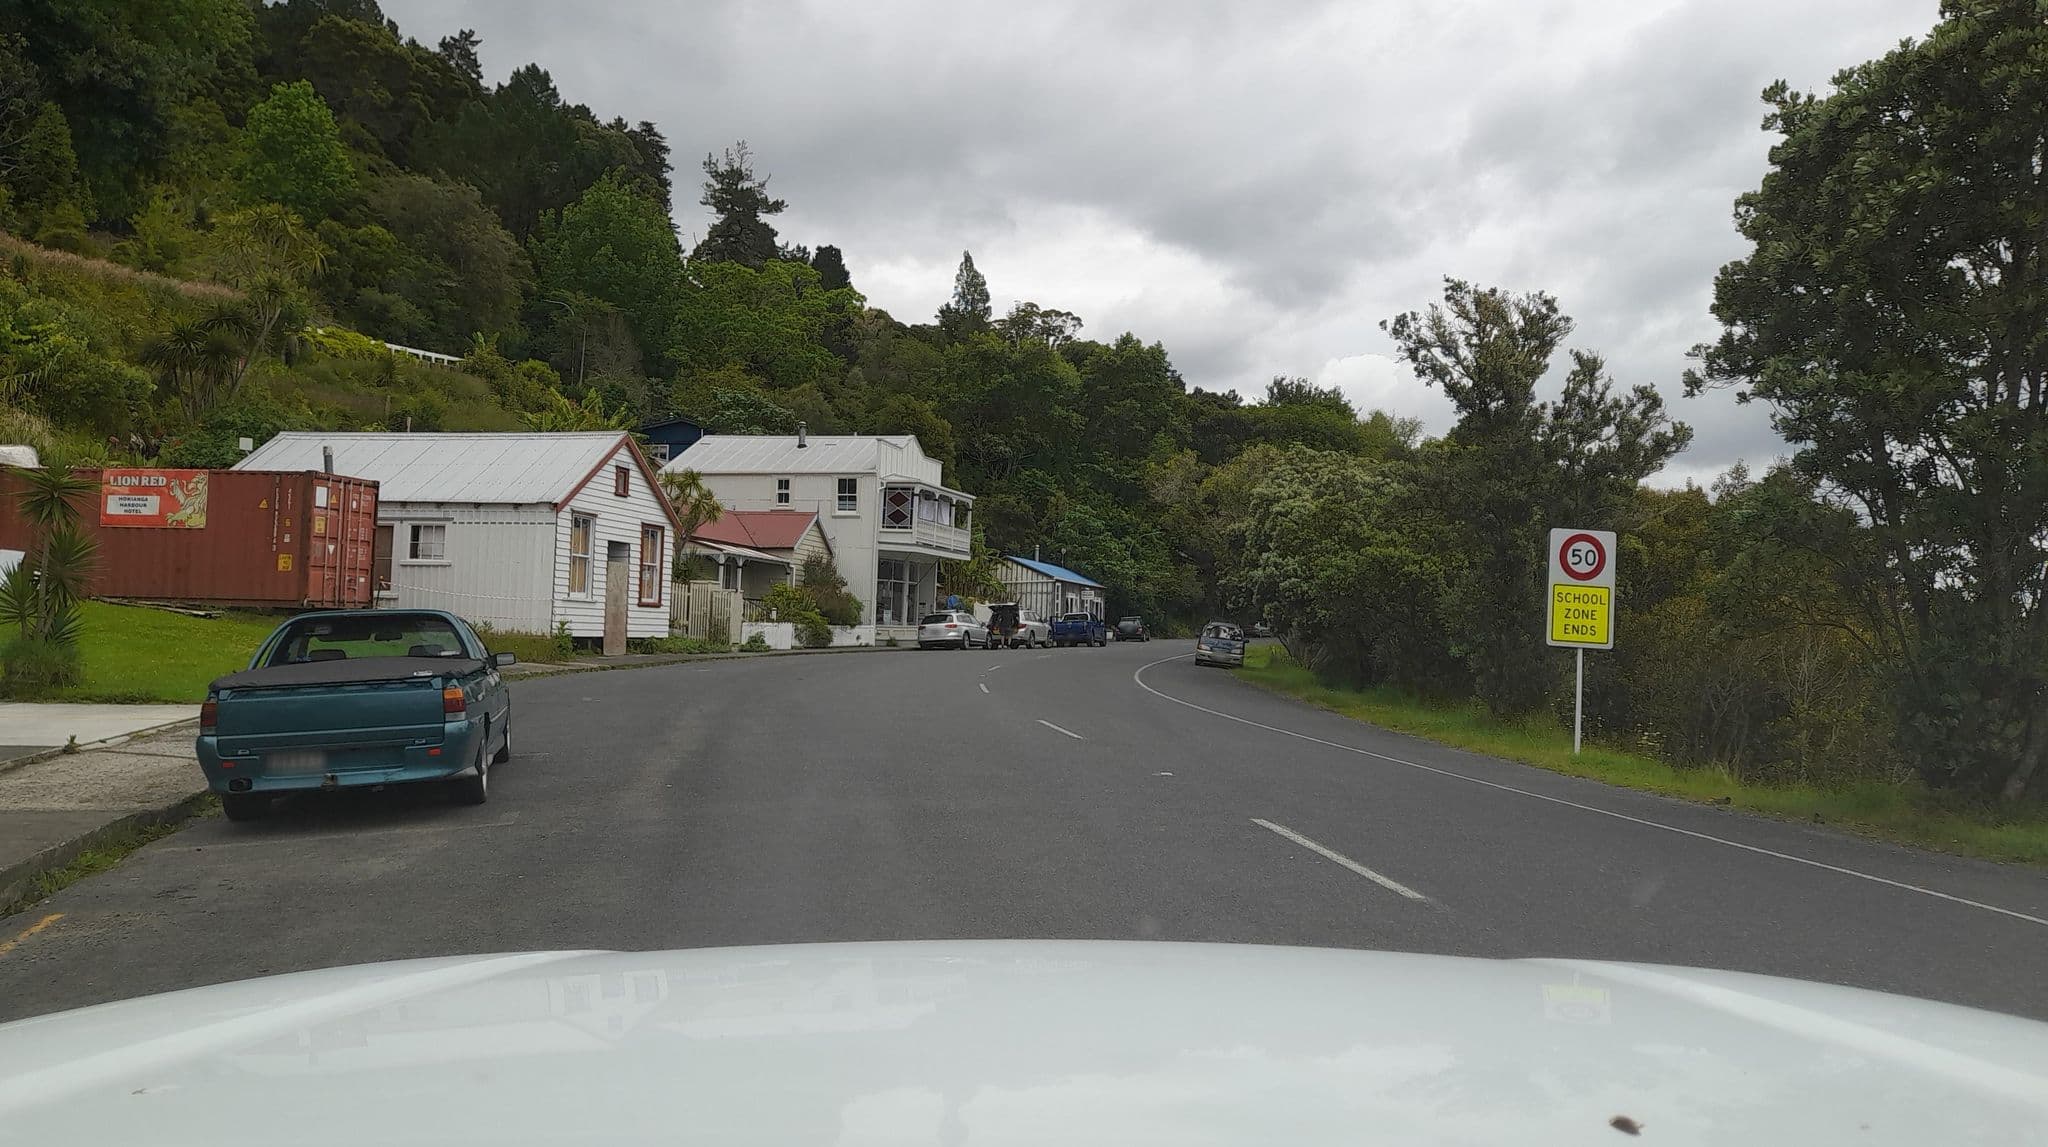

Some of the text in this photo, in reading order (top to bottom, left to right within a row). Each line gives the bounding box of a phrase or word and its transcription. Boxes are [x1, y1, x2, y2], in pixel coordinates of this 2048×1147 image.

[109, 475, 167, 487] LION RED
[1571, 549, 1597, 566] 50
[1556, 591, 1606, 605] SCHOOL
[1564, 608, 1598, 621] ZONE
[1563, 624, 1597, 636] ENDS
